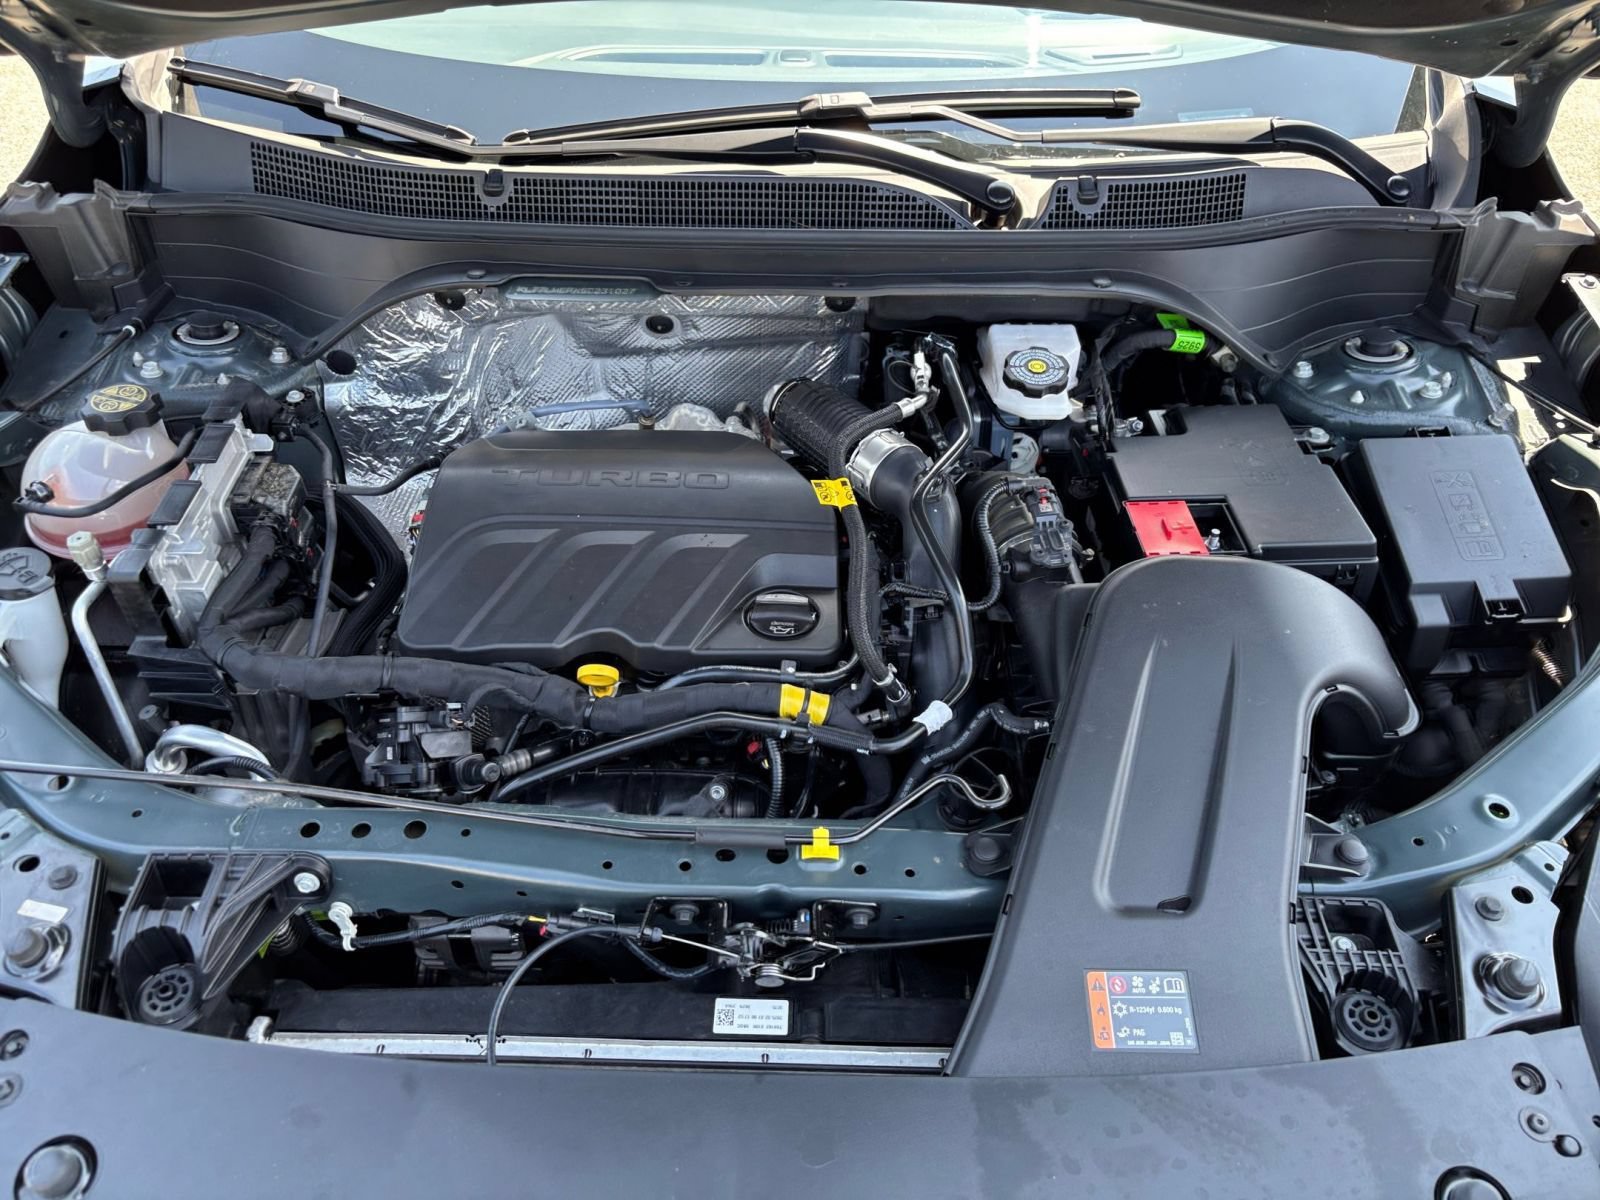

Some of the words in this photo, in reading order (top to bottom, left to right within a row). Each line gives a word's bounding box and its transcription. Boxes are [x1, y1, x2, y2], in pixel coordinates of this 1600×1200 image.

[1176, 340, 1201, 351] 5925
[492, 467, 730, 489] TURBO
[1174, 1006, 1183, 1015] kg
[1132, 1028, 1146, 1036] PAG
